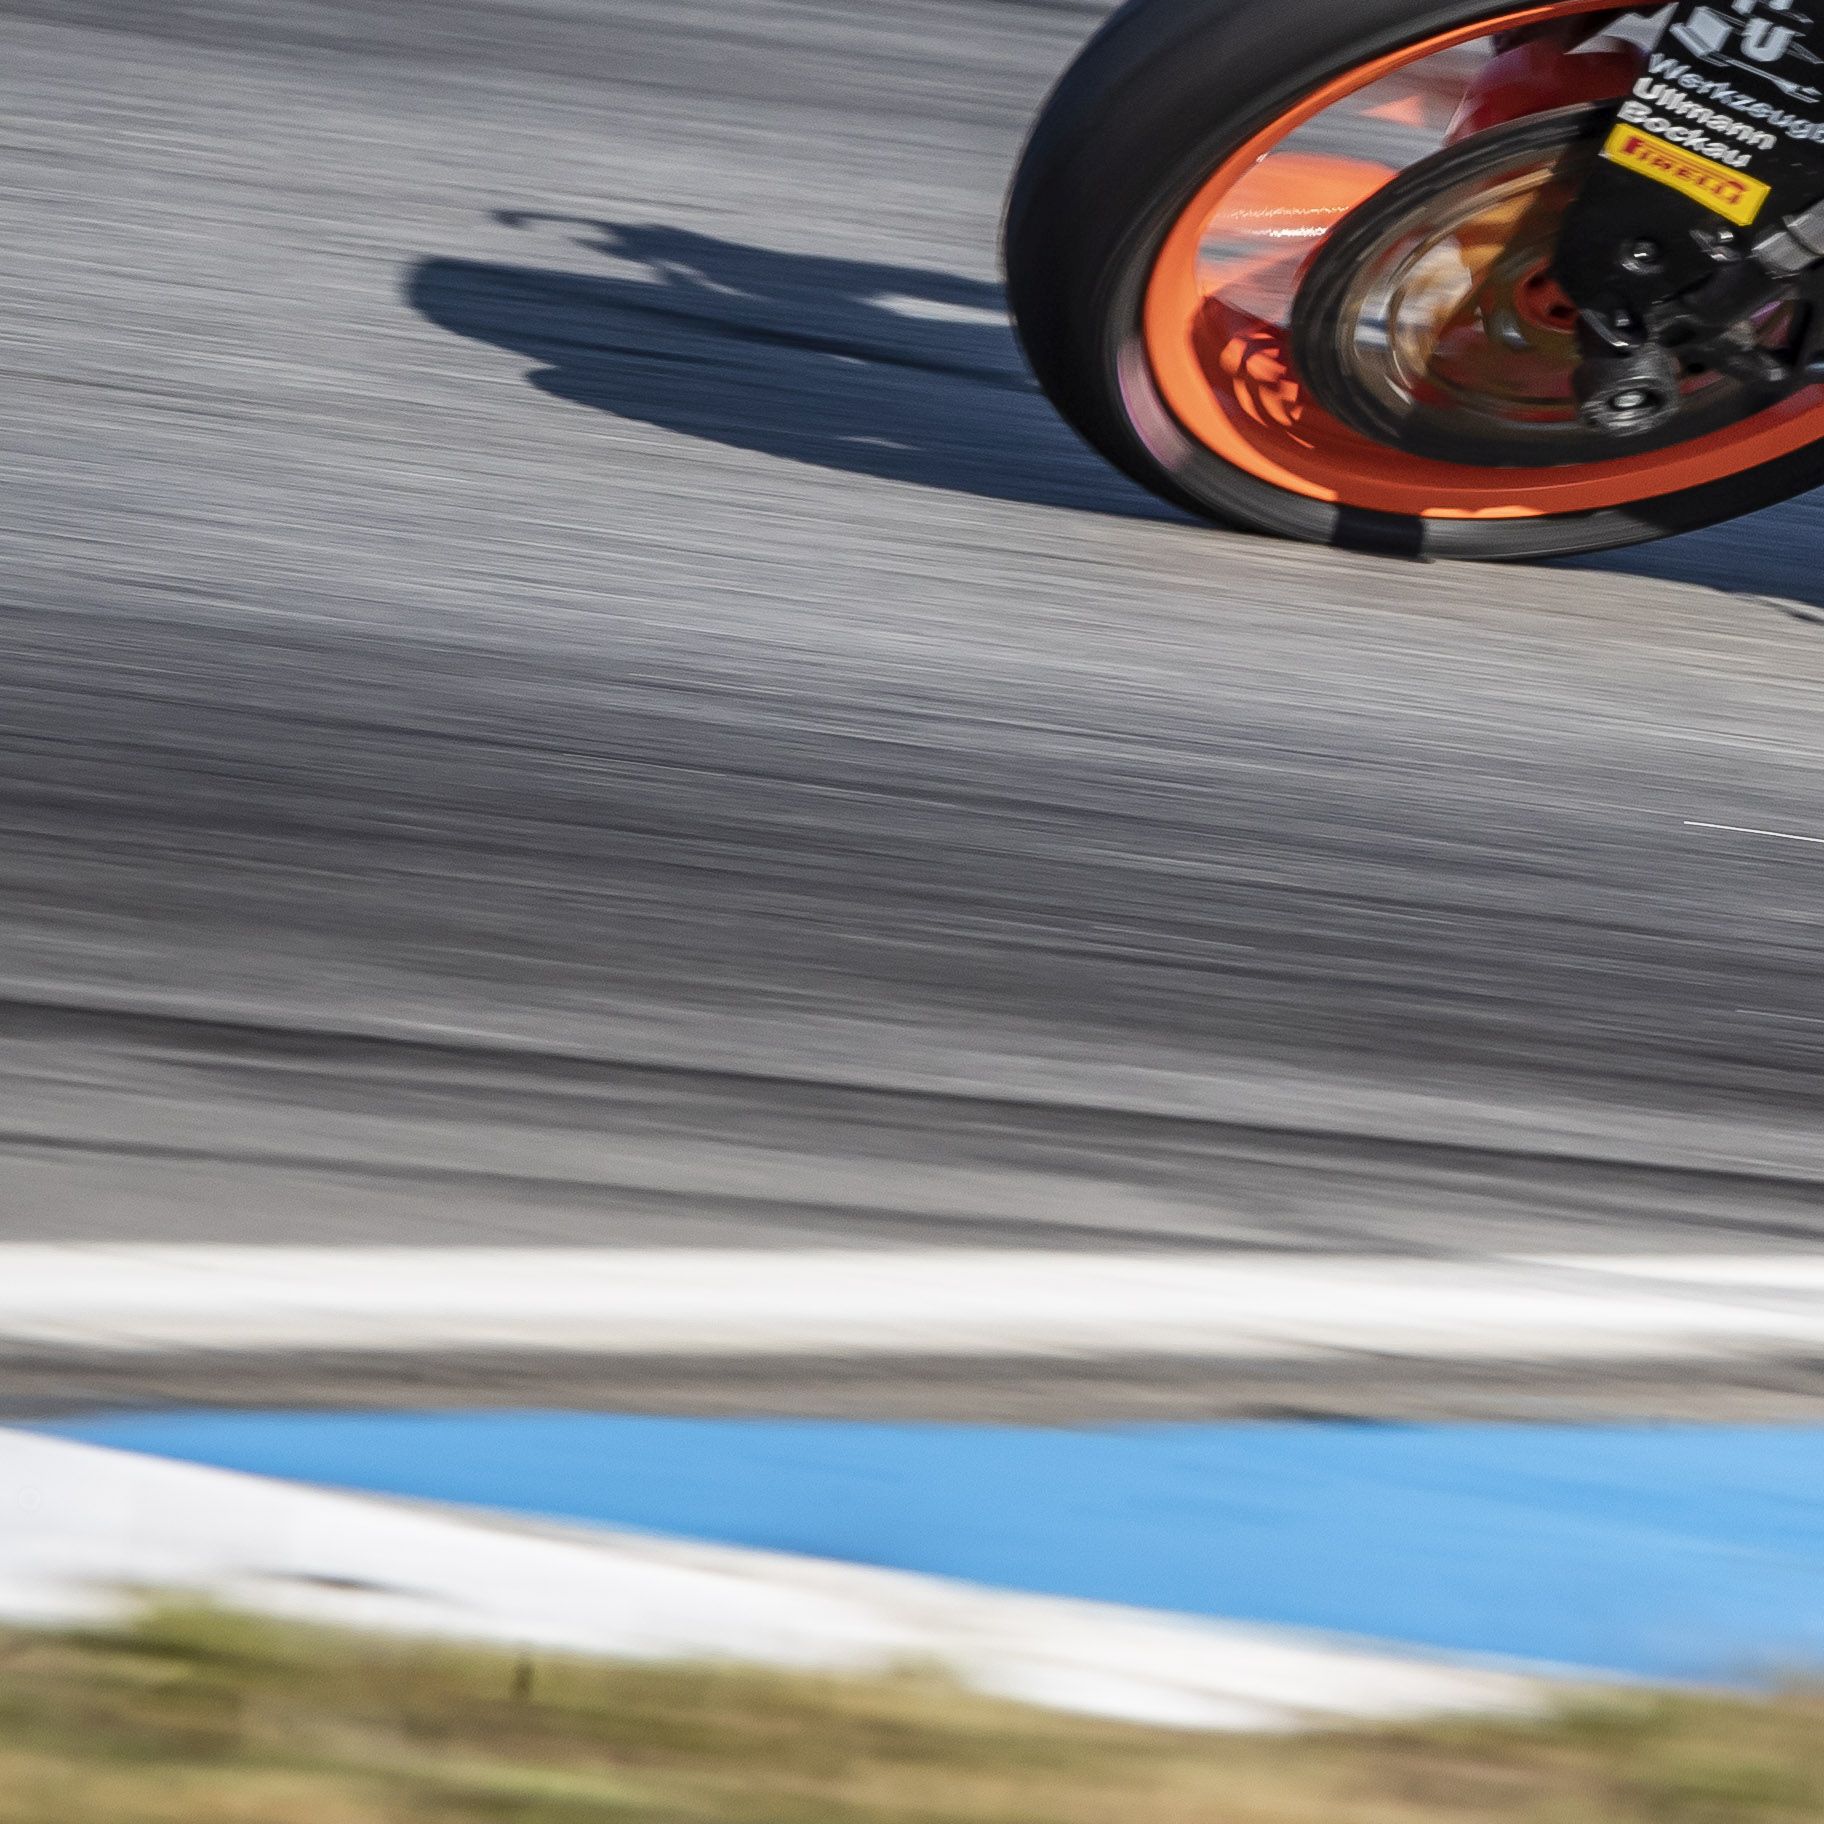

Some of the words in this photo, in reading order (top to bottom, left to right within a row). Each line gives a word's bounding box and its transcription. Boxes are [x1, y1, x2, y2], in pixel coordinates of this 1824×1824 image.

[1617, 99, 1753, 170] Bockau
[1632, 76, 1777, 152] Ullmann
[1620, 134, 1748, 208] PIRELLI
